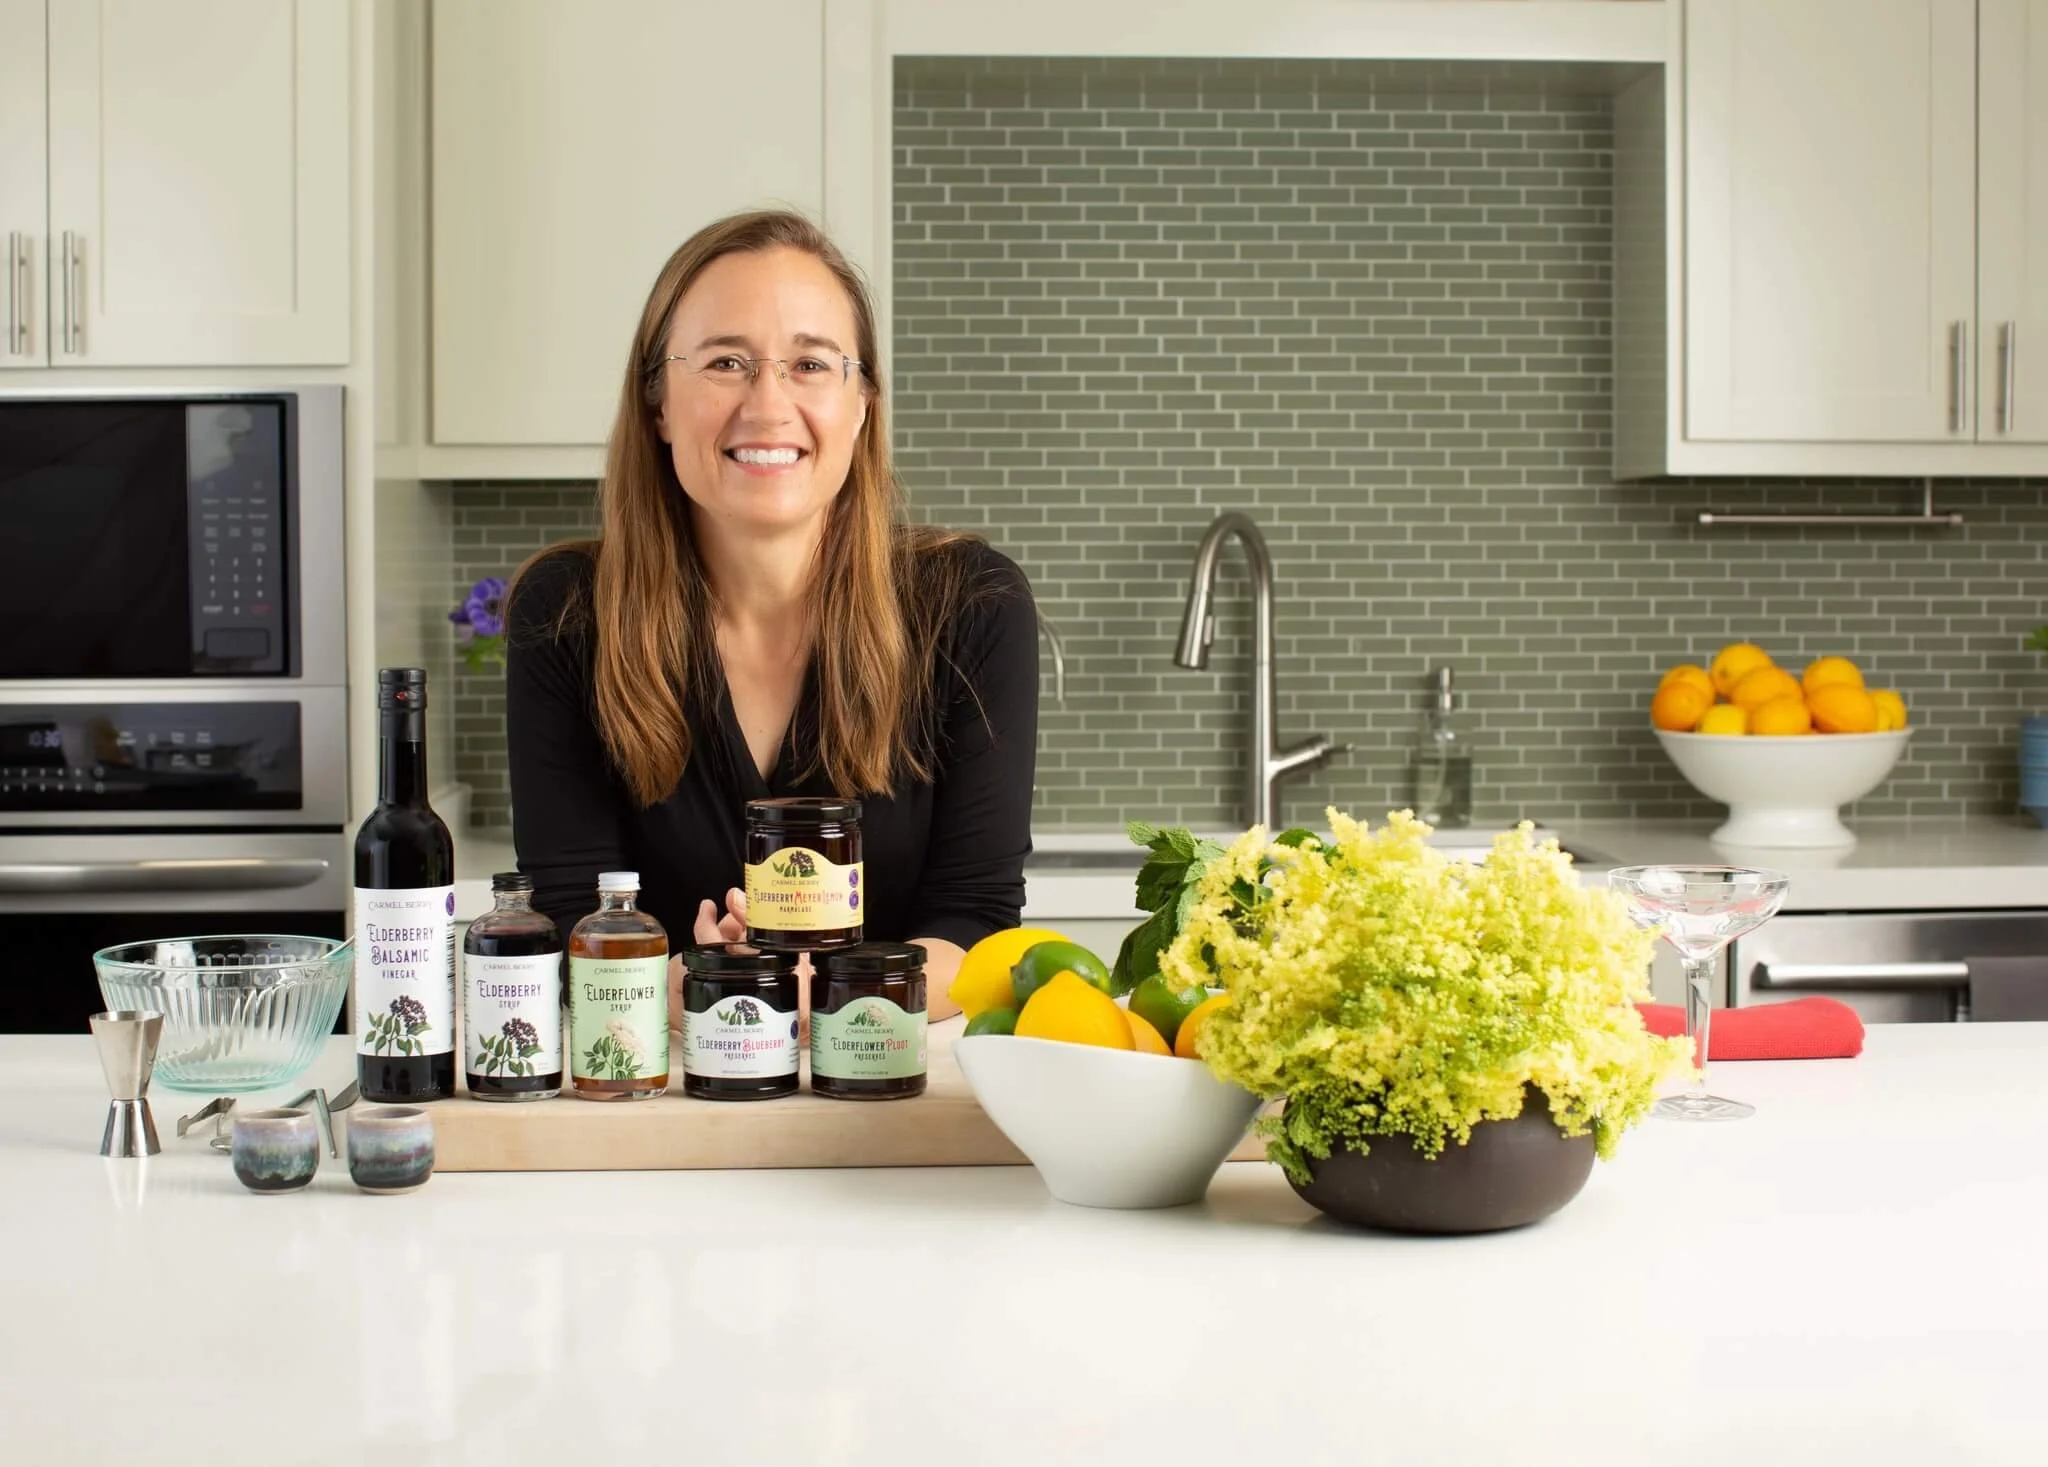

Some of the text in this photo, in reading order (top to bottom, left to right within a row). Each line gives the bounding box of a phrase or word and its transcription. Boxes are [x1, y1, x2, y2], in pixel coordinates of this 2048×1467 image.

[771, 879, 799, 887] CARMEL
[368, 901, 402, 911] CARMEL
[366, 923, 435, 943] ELDERBERRY
[371, 946, 430, 965] BALSAMIC
[483, 963, 511, 971] CARMEL
[594, 967, 623, 975] CARMEL
[381, 969, 419, 981] VINEGAR
[476, 979, 543, 999] ELDERBERRY
[583, 983, 656, 1002] ELDERFLOWER
[498, 1000, 521, 1011] SYRUP
[610, 1003, 632, 1014] SYRUP
[724, 1052, 756, 1061] PRESERVES
[854, 1052, 886, 1062] PRESERVES
